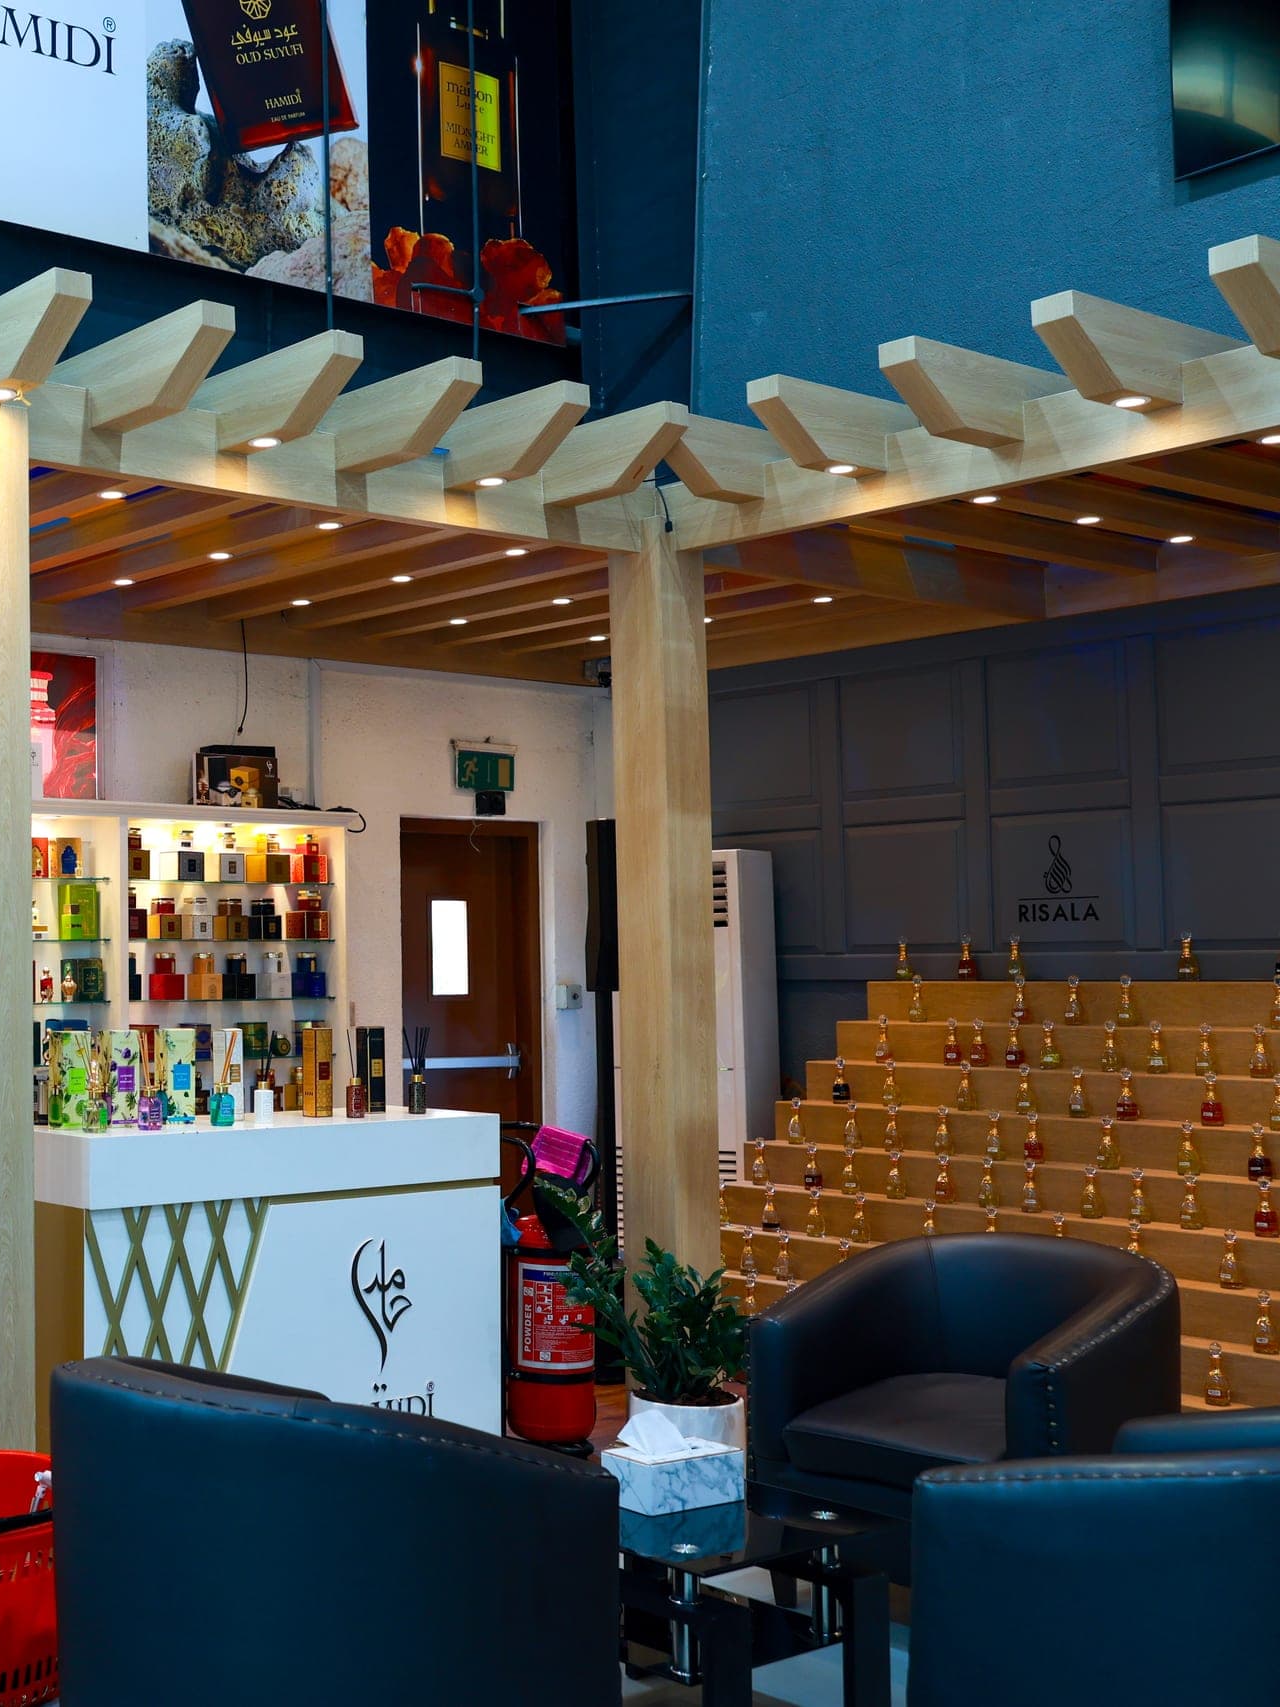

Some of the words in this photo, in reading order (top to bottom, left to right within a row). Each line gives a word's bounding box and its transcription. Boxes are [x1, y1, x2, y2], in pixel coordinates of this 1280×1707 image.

[274, 24, 298, 42] عود
[236, 50, 261, 65] OUD
[263, 43, 304, 60] SUYUFI
[264, 93, 302, 110] HAMIDI
[446, 81, 493, 105] maion
[455, 138, 488, 157] AMER
[1018, 902, 1100, 922] RISALA
[524, 1304, 532, 1353] POWDER
